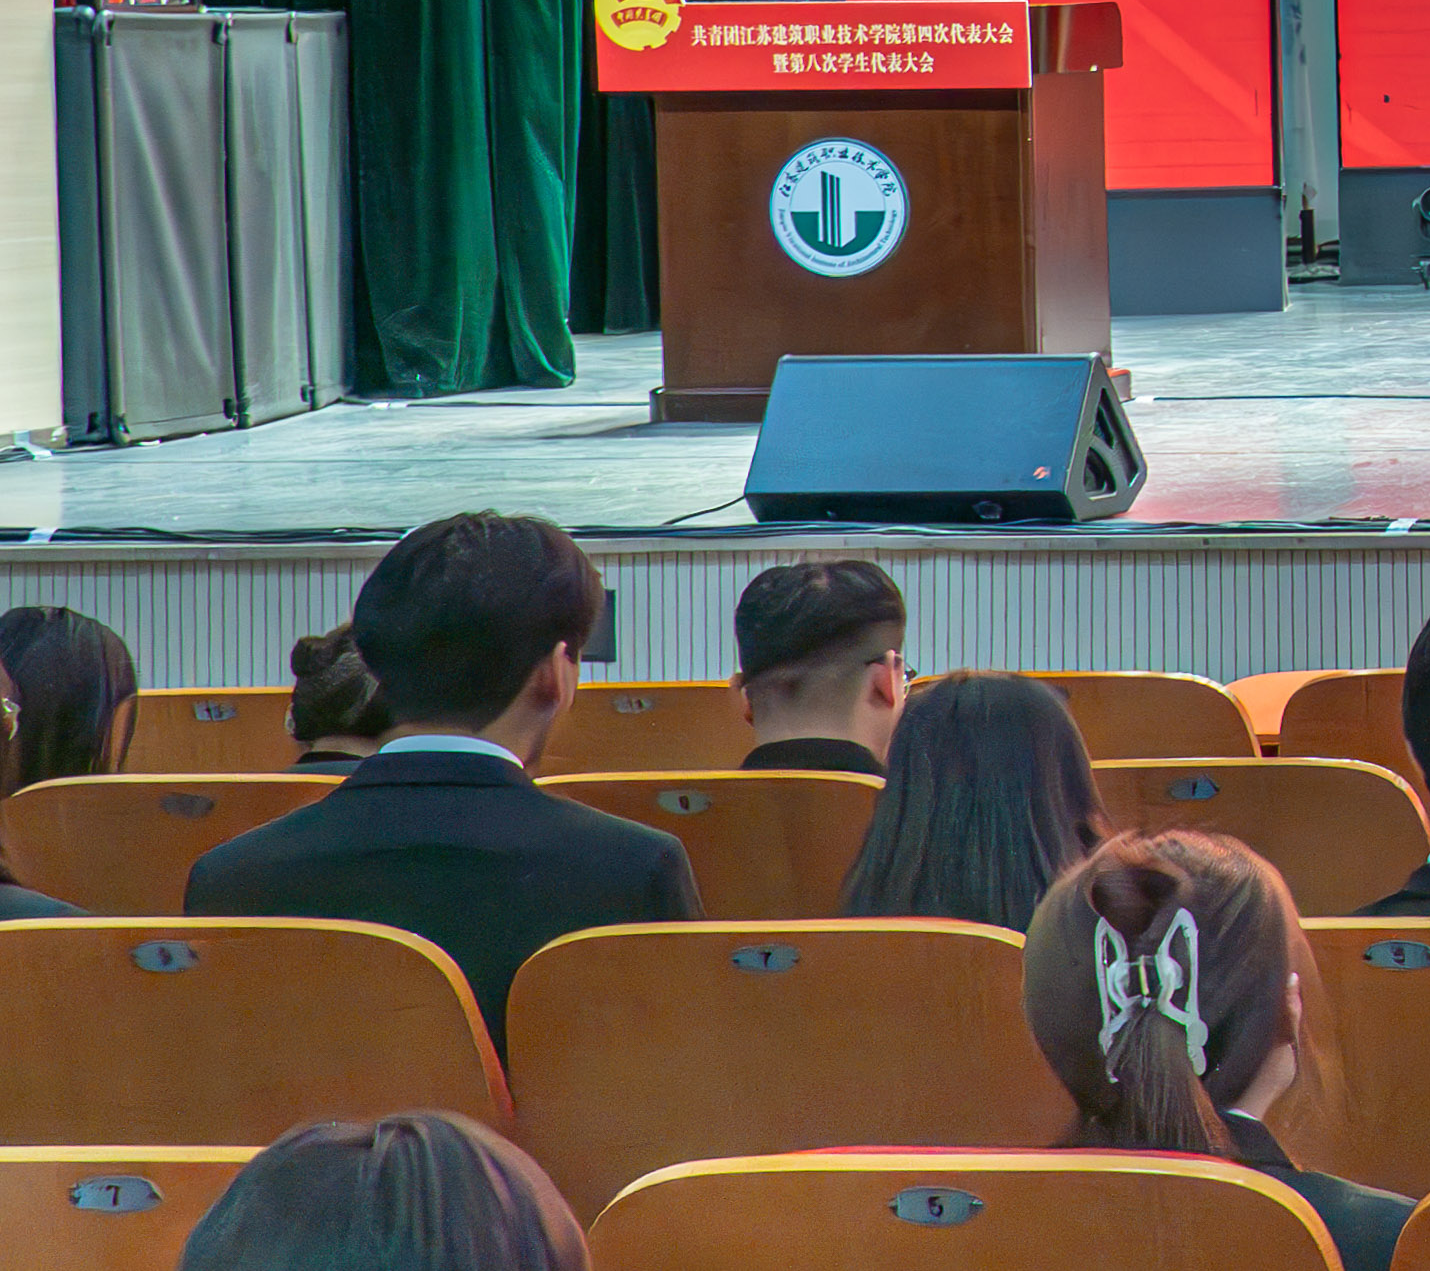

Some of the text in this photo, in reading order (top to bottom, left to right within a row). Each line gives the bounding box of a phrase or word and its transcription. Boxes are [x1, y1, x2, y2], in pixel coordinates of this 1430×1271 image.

[691, 23, 1014, 47] 共青团江苏建筑职业技术学院第四次代表大会
[772, 51, 935, 75] 暨第八次学生代表大会
[106, 1184, 120, 1207] 7
